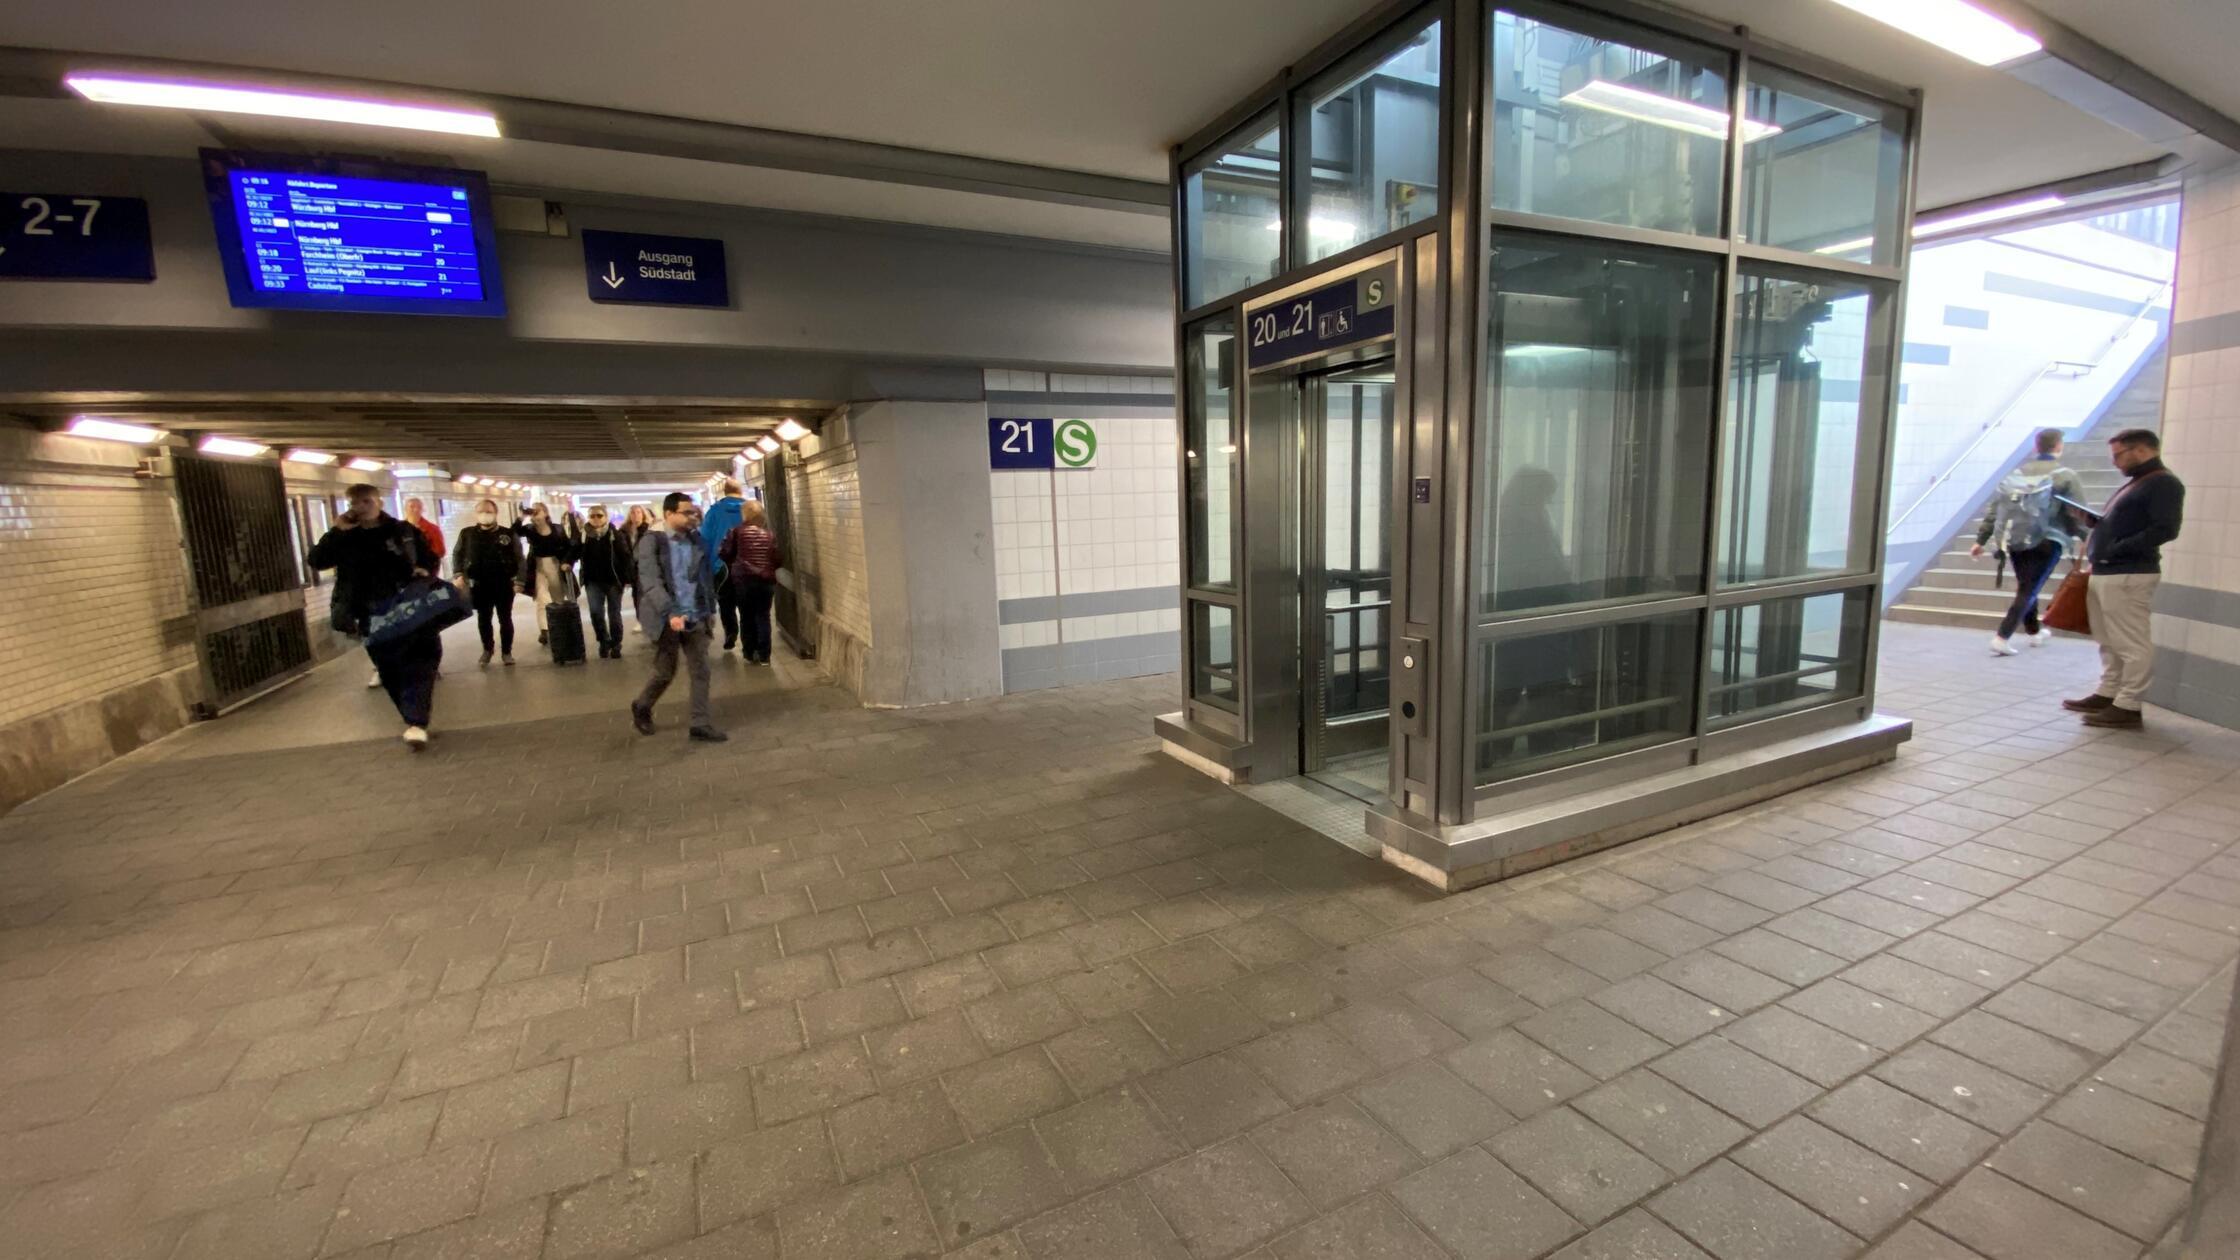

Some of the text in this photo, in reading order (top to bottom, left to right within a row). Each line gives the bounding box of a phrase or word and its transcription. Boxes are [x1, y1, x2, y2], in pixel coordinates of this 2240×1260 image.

[246, 200, 269, 209] 09:12
[21, 197, 101, 236] 2-7
[435, 258, 446, 266] 20
[638, 249, 694, 267] Ausgang
[438, 272, 448, 281] 21
[639, 265, 696, 281] Südstadt
[1367, 280, 1382, 305] S
[1254, 300, 1313, 347] 20 und 21
[1001, 420, 1090, 462] 21 S
